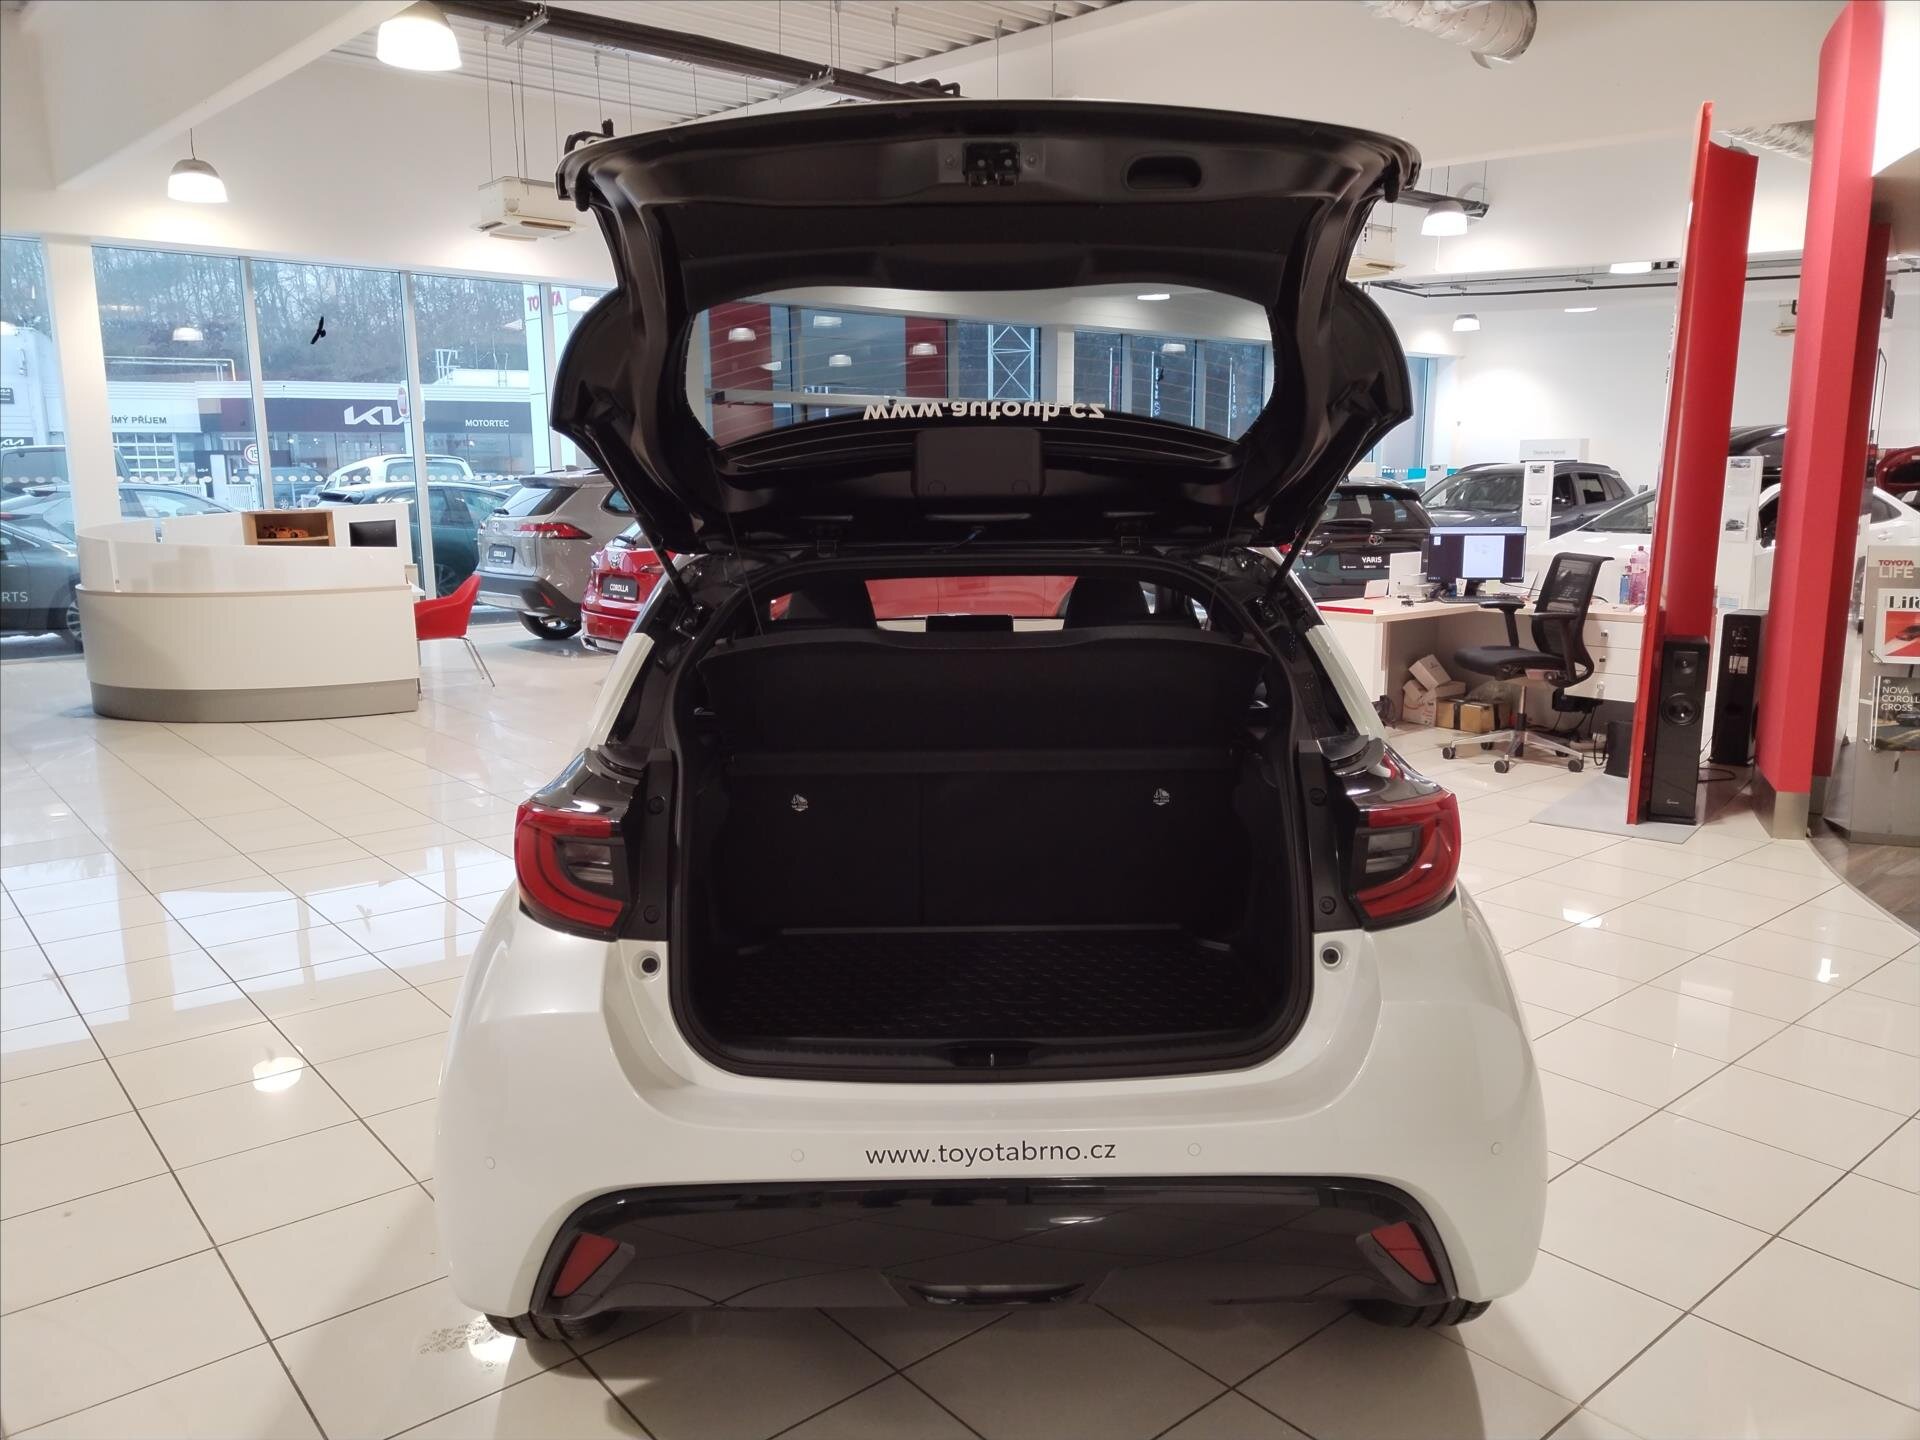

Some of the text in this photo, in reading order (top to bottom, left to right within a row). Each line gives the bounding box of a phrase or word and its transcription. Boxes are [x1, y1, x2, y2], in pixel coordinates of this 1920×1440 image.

[527, 290, 563, 312] TOTA
[131, 414, 168, 425] PŘÍJEM
[465, 419, 510, 428] MOTORTEC
[1361, 556, 1382, 564] YARIS
[1878, 559, 1915, 567] TOYOTA
[1879, 567, 1915, 579] LIFE
[609, 583, 629, 593] COROLLA
[1880, 703, 1913, 712] CROSS
[865, 1140, 1116, 1168] www.toyotabrno.cz
